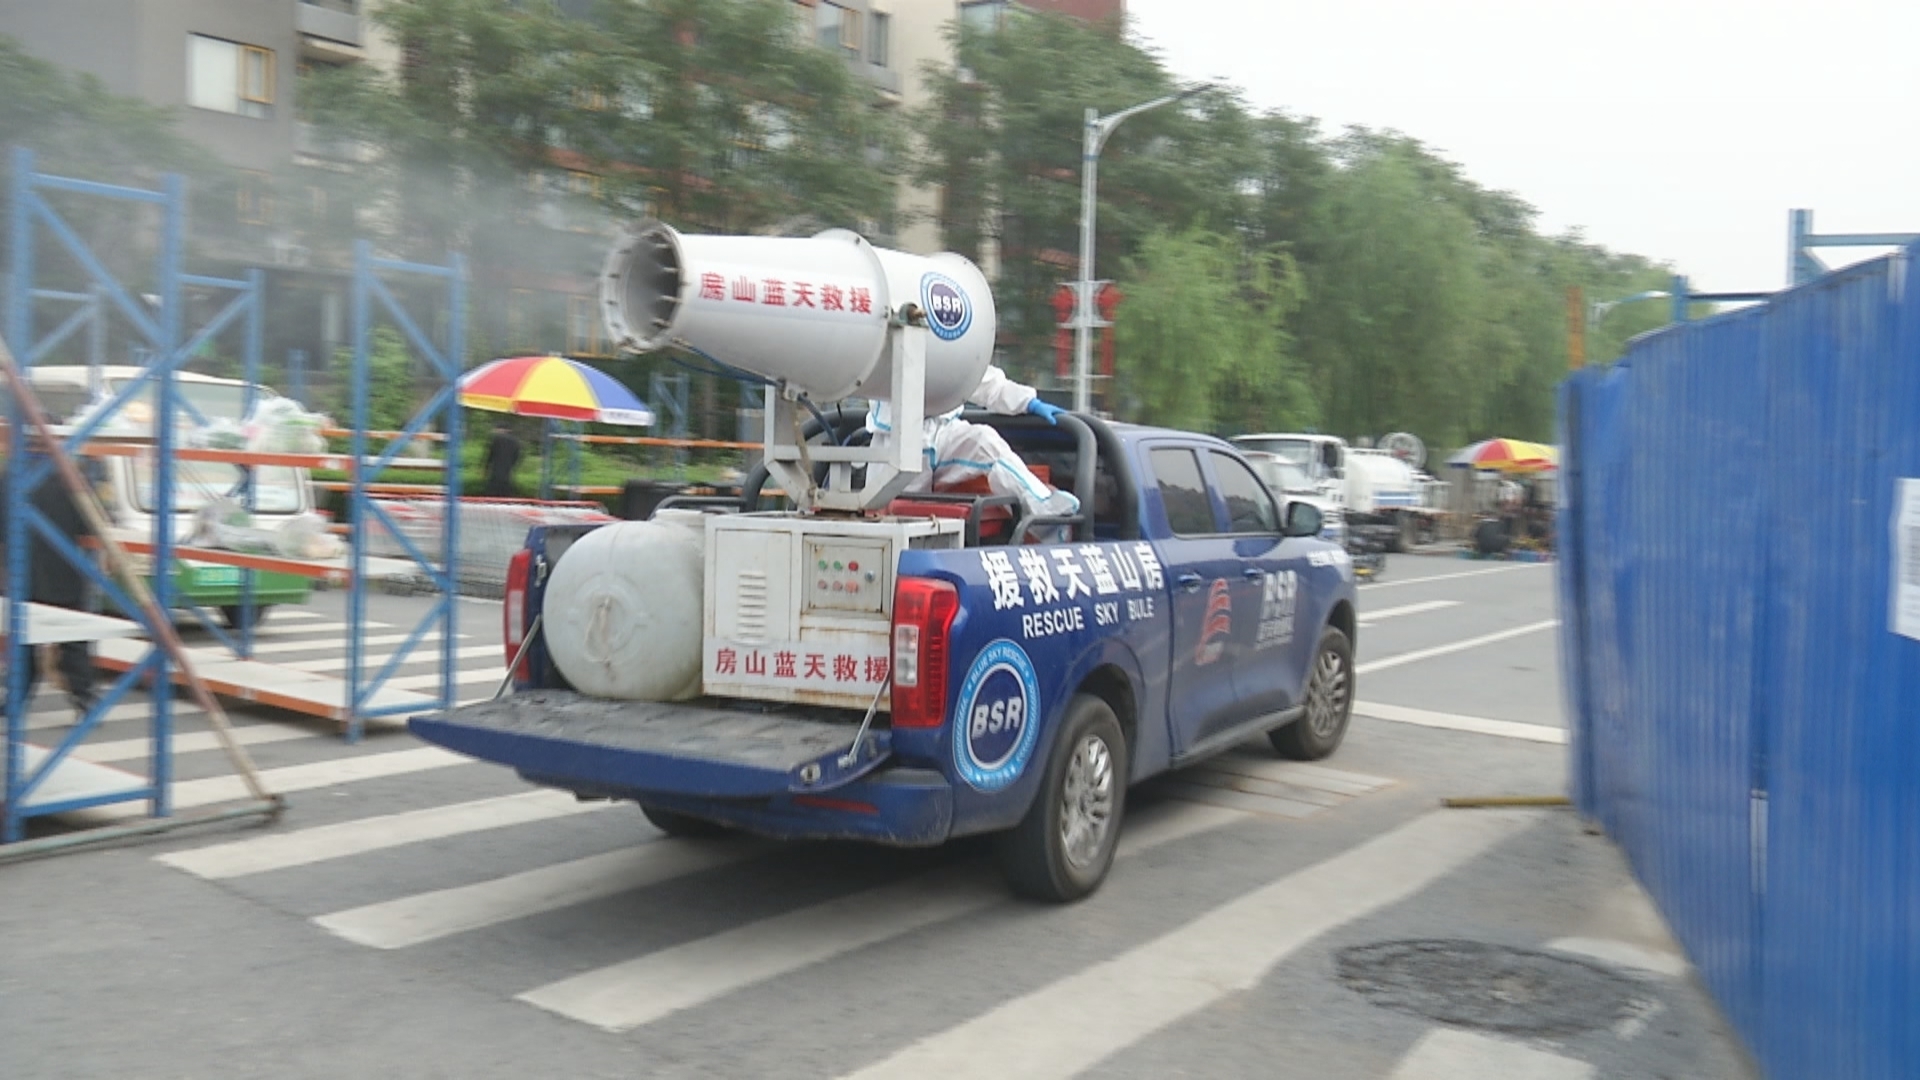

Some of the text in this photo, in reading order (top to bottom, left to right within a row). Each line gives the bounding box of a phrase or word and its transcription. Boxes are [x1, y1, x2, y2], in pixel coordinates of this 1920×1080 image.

[698, 272, 872, 315] 房山蓝天救援
[932, 294, 961, 314] BSR
[979, 541, 1165, 611] 援救天蓝山房
[1022, 596, 1155, 639] RESCUE SKY BULE
[715, 648, 888, 684] 房山蓝天救援
[971, 696, 1022, 740] BSR
